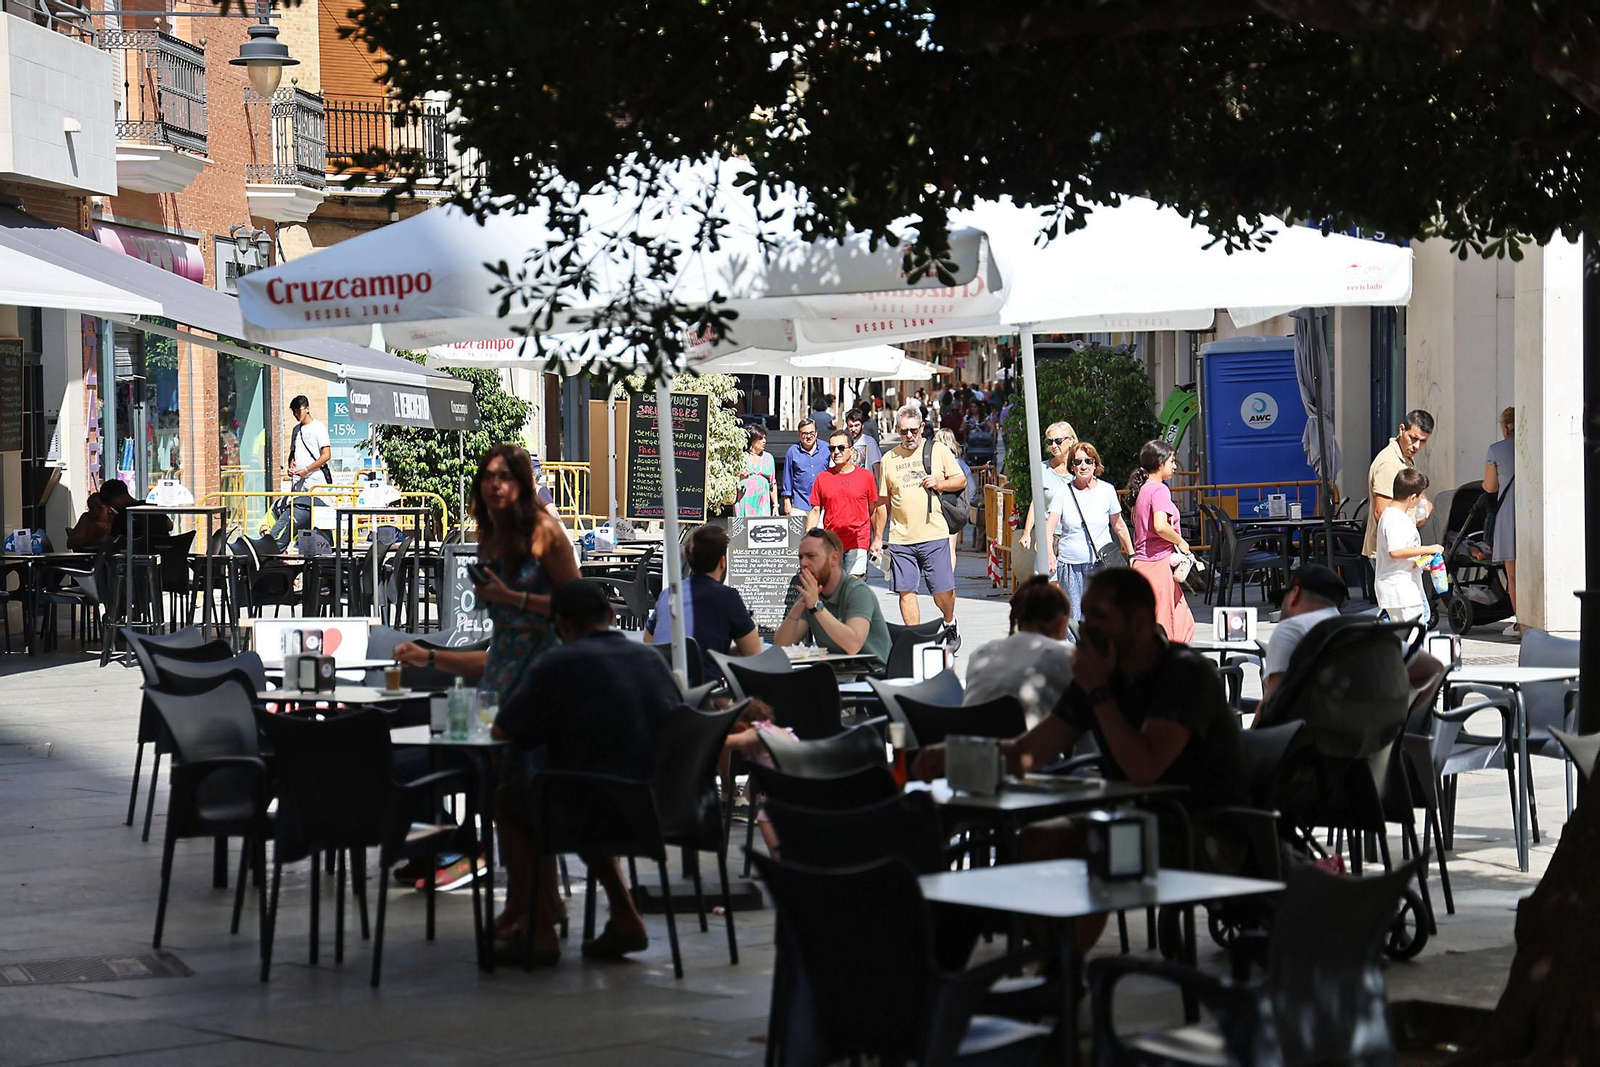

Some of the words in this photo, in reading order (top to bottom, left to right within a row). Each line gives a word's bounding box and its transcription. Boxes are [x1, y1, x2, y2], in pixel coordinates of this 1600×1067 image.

[266, 271, 432, 305] Cruzcampo
[1346, 282, 1383, 291] reciclado
[305, 307, 351, 321] DESDE
[362, 303, 400, 317] 1904
[855, 320, 894, 333] DESDE
[1249, 413, 1271, 422] AWC
[330, 423, 357, 436] -15%
